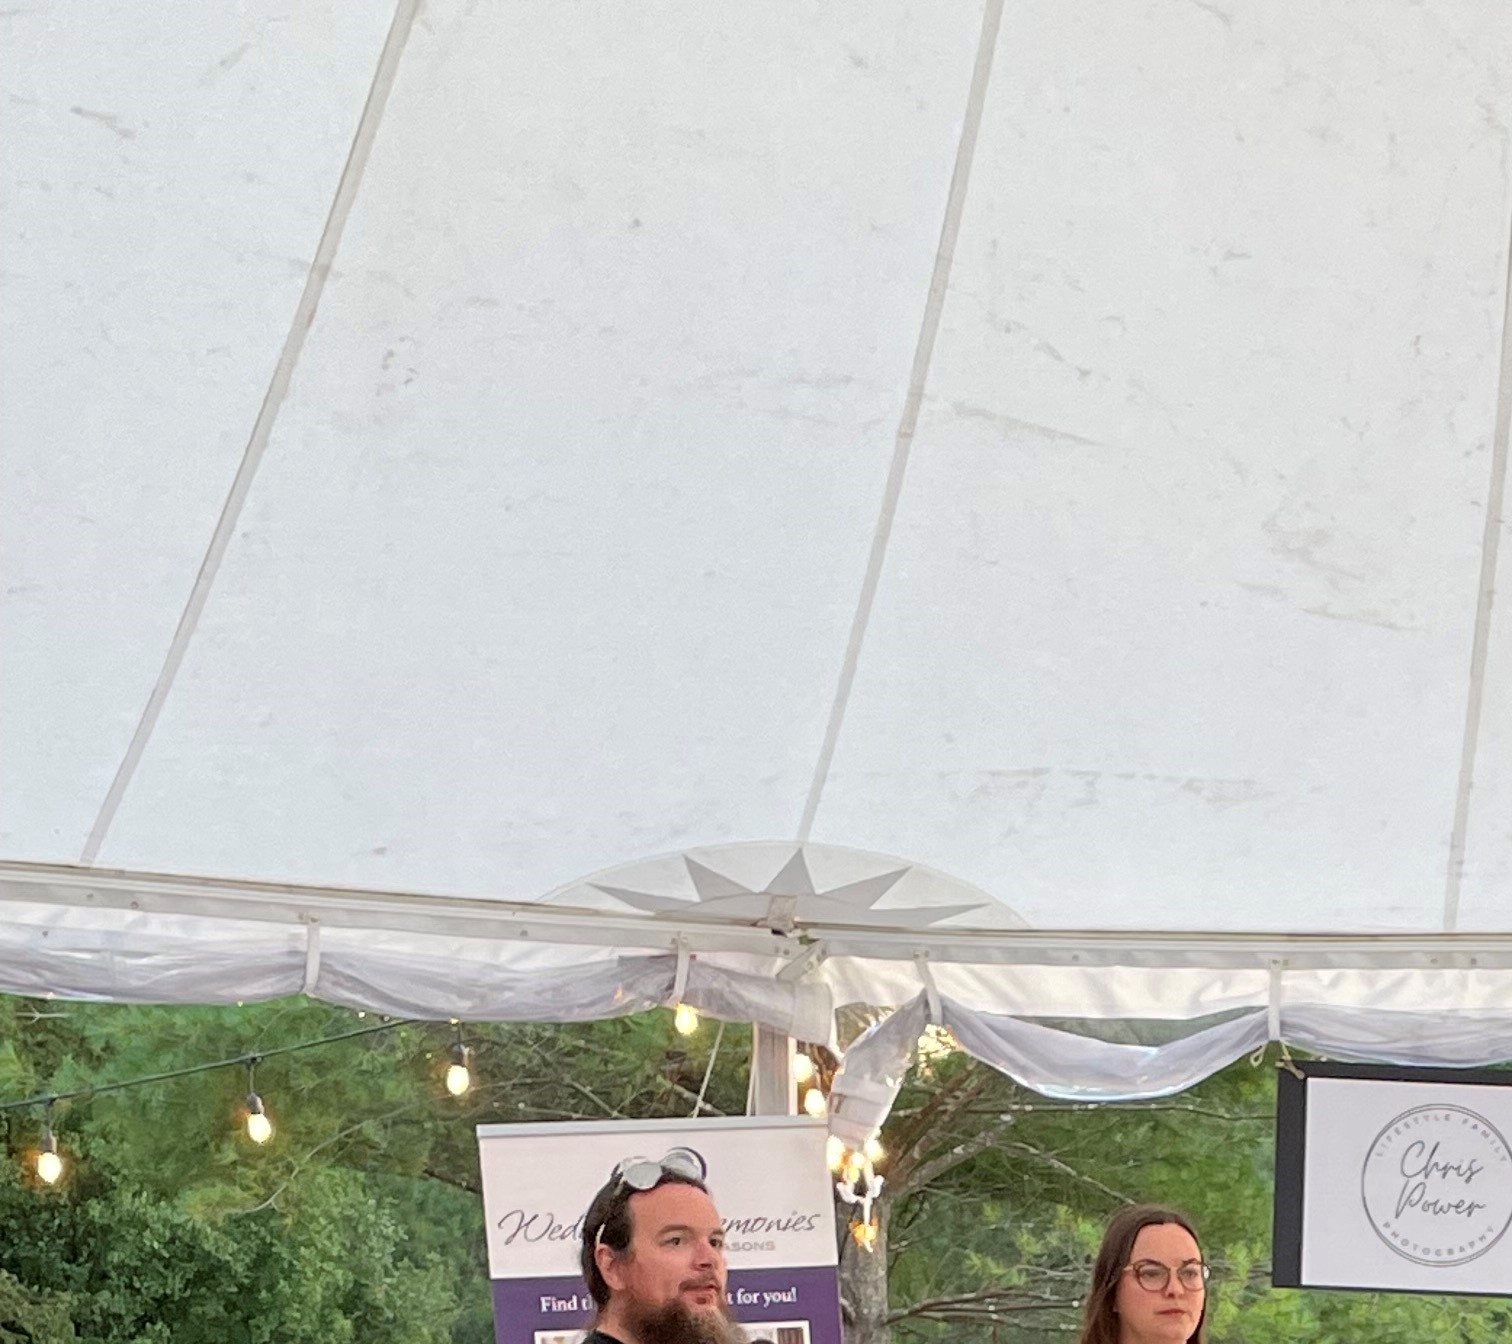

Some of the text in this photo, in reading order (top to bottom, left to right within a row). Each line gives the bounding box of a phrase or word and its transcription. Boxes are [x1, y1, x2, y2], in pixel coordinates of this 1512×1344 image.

[1400, 1139, 1484, 1185] Chris
[1394, 1179, 1487, 1219] Power
[498, 1209, 821, 1246] Wed monies
[1383, 1221, 1495, 1257] PHOTOGRAPHY
[540, 1294, 578, 1312] Find
[737, 1288, 760, 1304] for
[763, 1287, 797, 1309] you!
